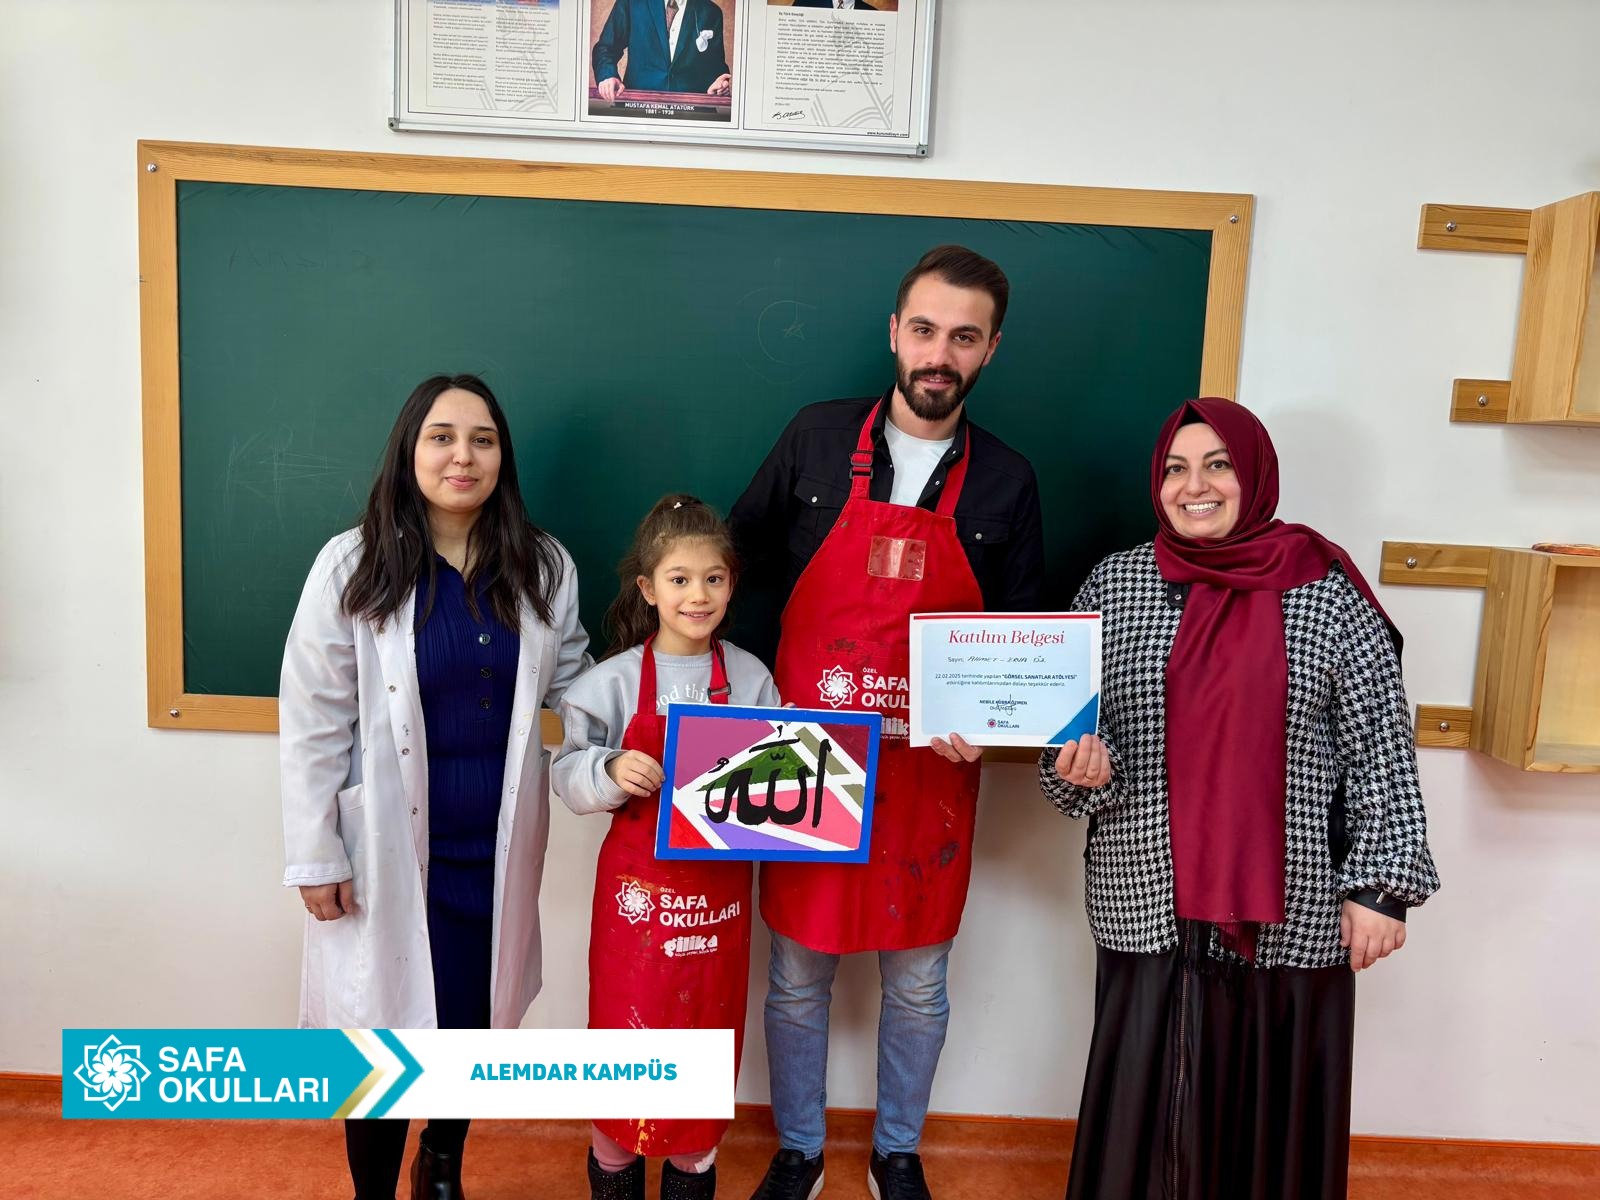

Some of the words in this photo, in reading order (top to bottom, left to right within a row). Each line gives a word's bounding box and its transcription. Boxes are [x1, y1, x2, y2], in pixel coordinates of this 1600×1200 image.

[624, 102, 650, 110] MUSTAFA
[949, 630, 1006, 644] Katılım
[1011, 630, 1065, 647] Belgesi
[862, 675, 909, 691] SAFA
[861, 692, 910, 709] OKUL
[660, 886, 676, 894] ÖZEL
[660, 894, 708, 910] SAFA
[660, 901, 740, 928] OKULLARI
